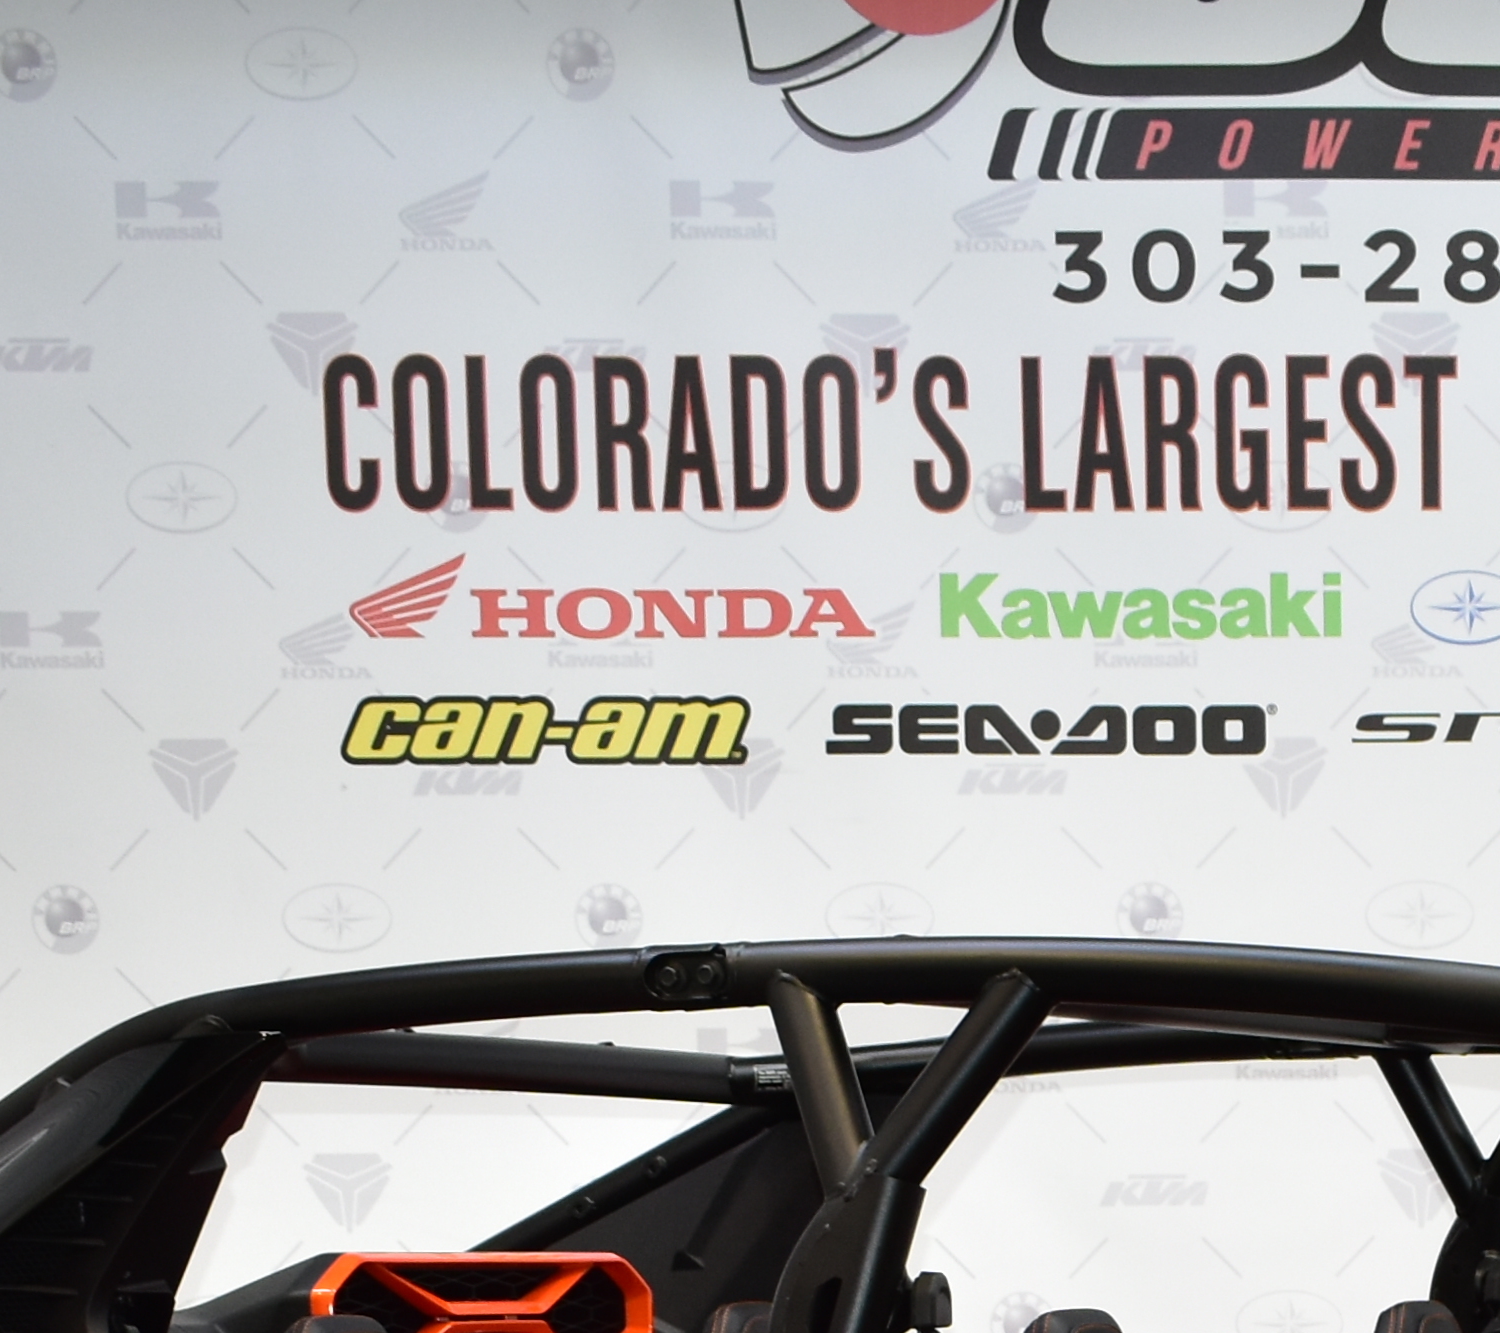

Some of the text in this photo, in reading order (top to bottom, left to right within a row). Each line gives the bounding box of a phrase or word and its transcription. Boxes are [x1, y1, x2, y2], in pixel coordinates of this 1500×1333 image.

[116, 221, 222, 240] Kawasaki
[669, 221, 777, 241] Kawasaki
[400, 236, 494, 252] HONDA
[954, 237, 1046, 252] HONDA
[322, 345, 972, 513] COLORADO'S
[1020, 352, 1458, 513] LARGEST
[470, 586, 875, 639] HONDA
[939, 572, 1343, 639] Kawasaki
[0, 651, 105, 670] Kawasaki
[548, 650, 653, 669] Kawasaki
[1094, 651, 1198, 669] Kawasaki
[281, 665, 373, 680] HONDA
[827, 664, 918, 678] HONDA
[1372, 664, 1464, 678] HONDA
[340, 695, 751, 766] can-am
[957, 763, 1068, 796] KTM
[1236, 1064, 1338, 1082] Kawasaki
[1100, 1174, 1208, 1207] KTM
